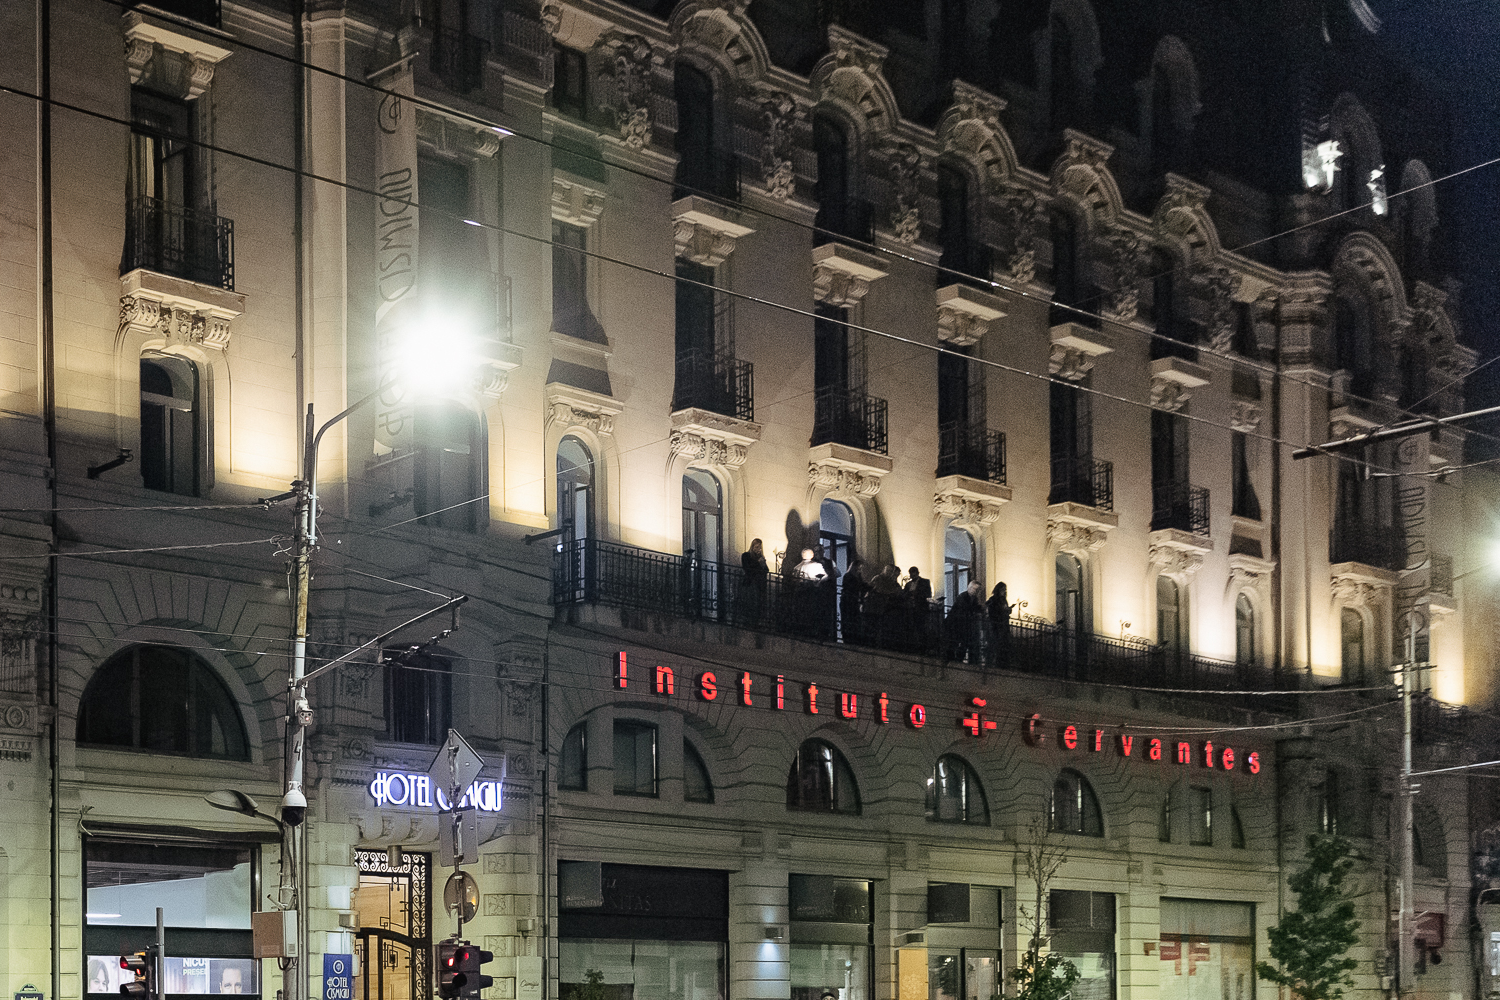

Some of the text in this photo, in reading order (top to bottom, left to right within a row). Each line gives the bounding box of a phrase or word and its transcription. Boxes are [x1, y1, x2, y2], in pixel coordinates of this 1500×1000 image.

[612, 650, 1261, 775] Instituto Cervantes
[370, 772, 432, 807] HOTEL
[326, 976, 348, 988] HOTEL
